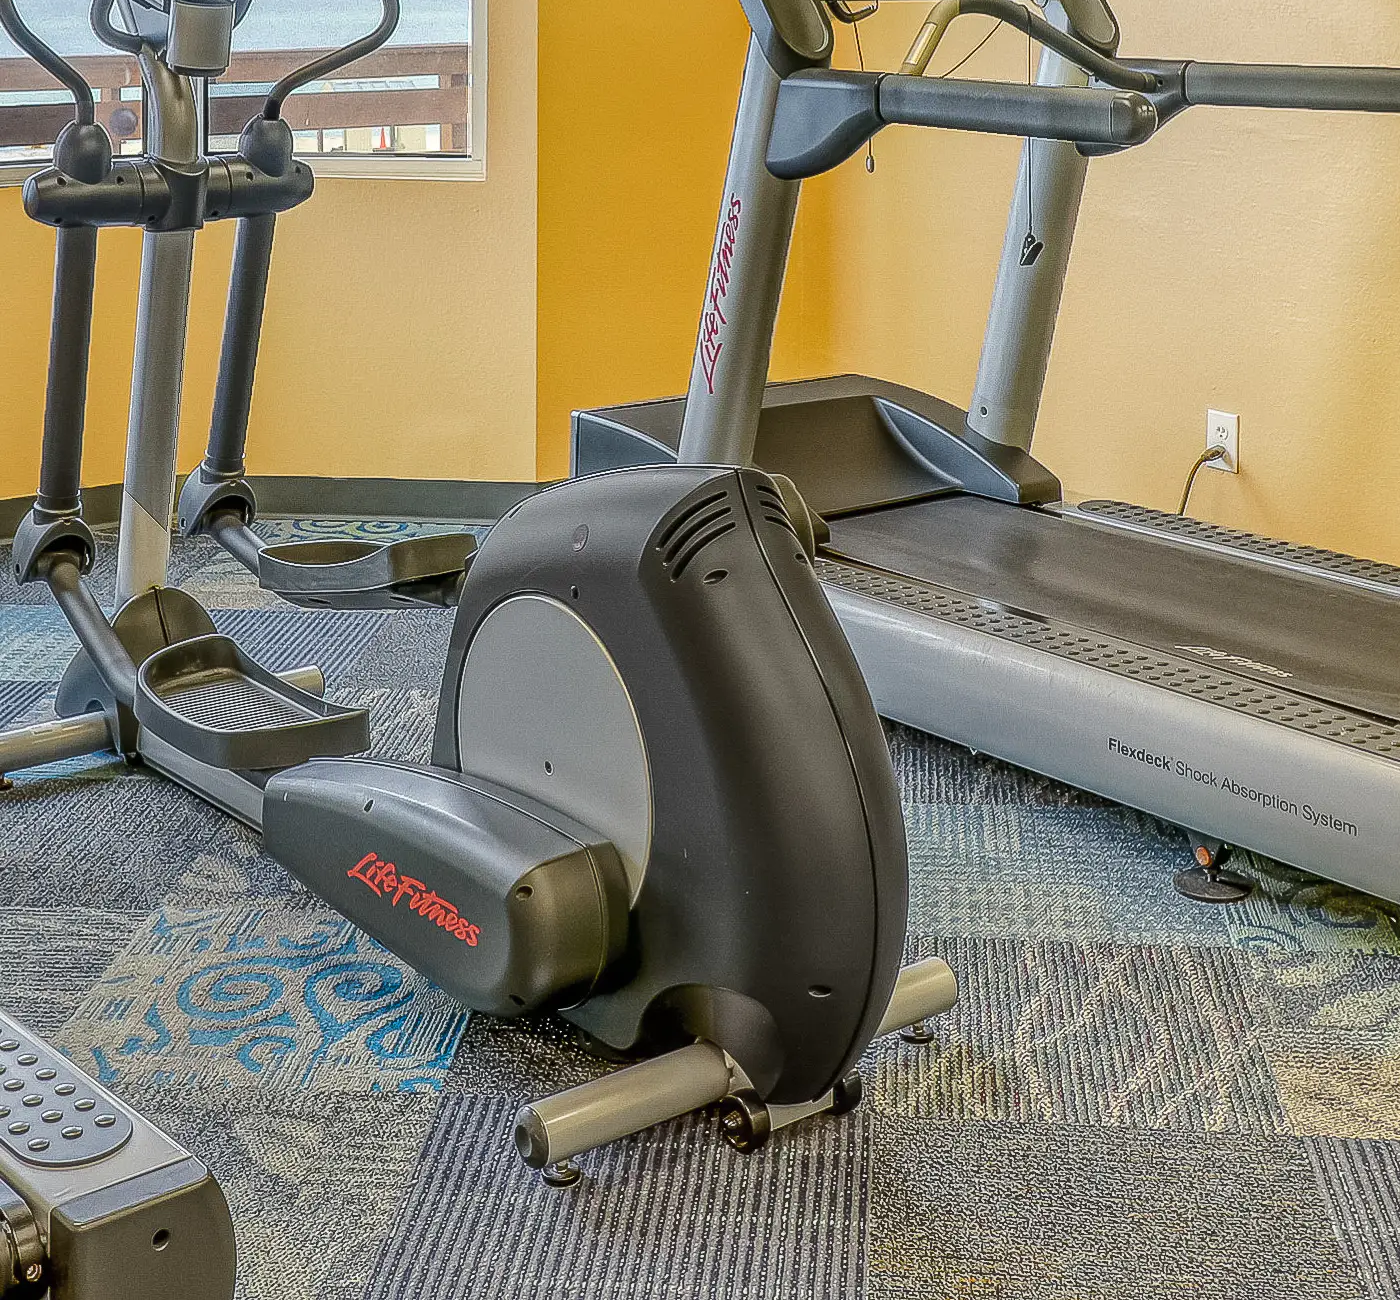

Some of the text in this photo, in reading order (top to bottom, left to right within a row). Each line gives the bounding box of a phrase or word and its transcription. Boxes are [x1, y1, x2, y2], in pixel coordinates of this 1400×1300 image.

[1175, 760, 1218, 788] Shock
[1220, 777, 1298, 817] Absorption
[1302, 804, 1359, 837] System
